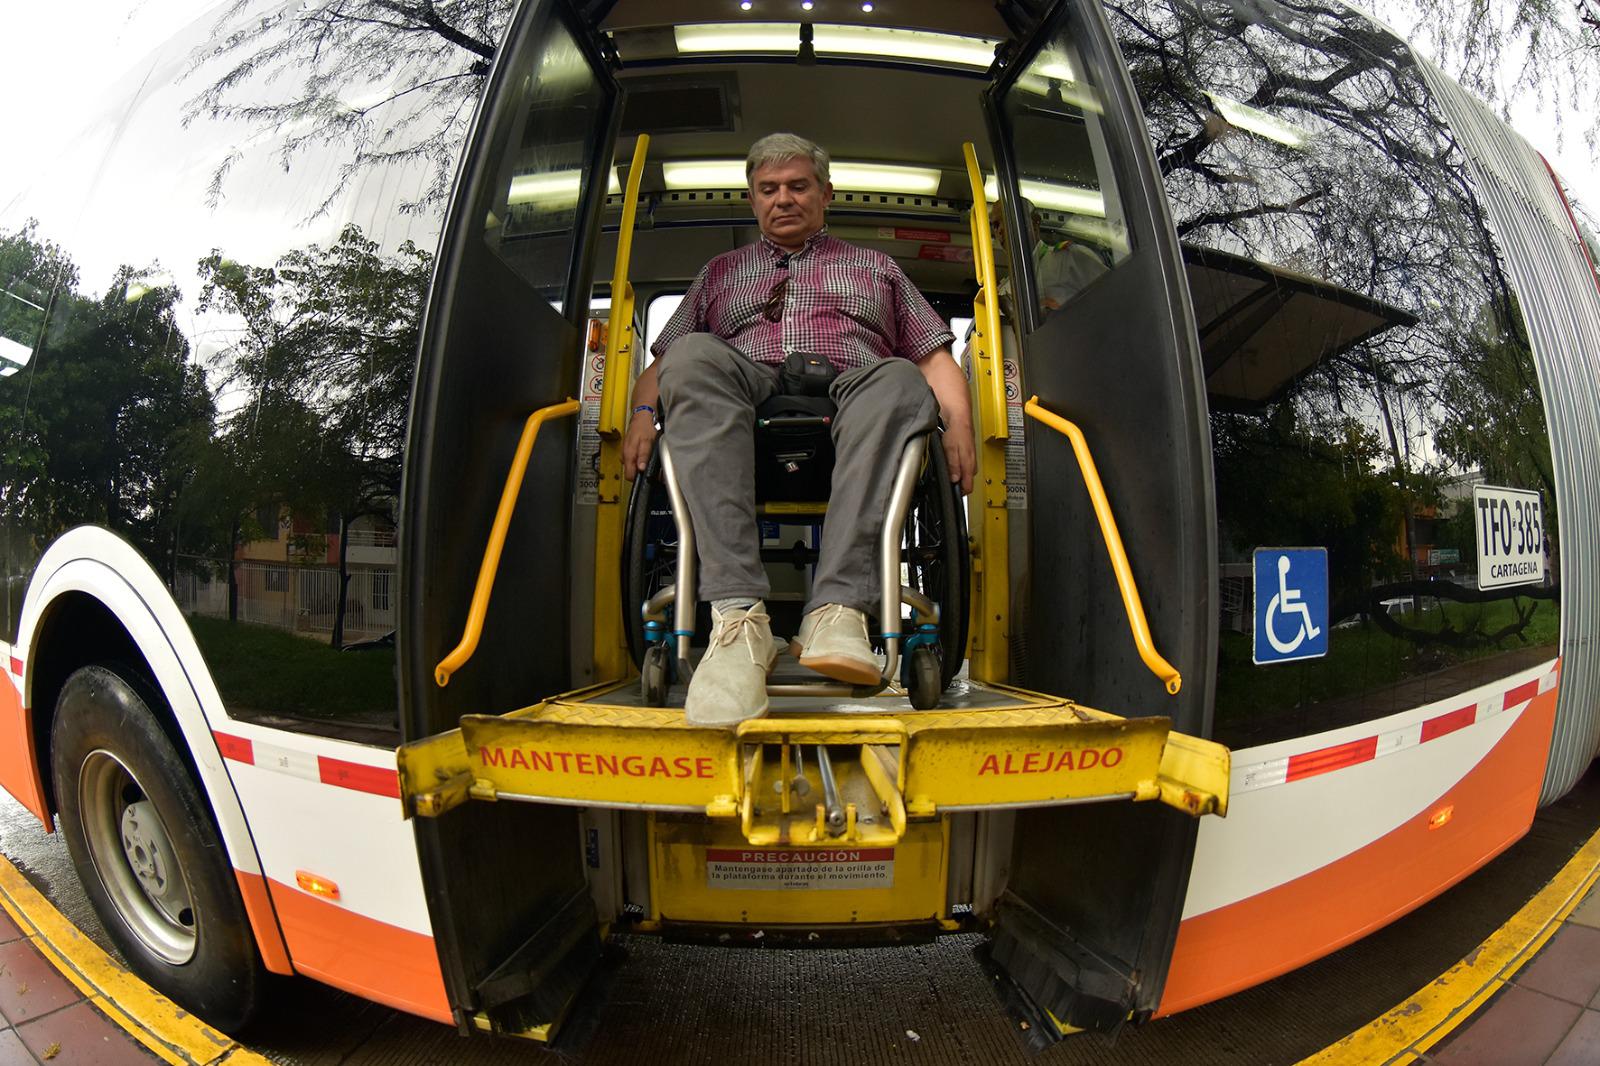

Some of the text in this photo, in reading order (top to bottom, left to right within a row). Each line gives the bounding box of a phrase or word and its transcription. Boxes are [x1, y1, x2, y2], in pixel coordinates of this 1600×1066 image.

[1490, 561, 1538, 578] CARTAGENA
[479, 746, 715, 778] MANTENGASE
[977, 747, 1124, 776] ALEJADO
[742, 850, 860, 862] PRECAUCIÓN
[776, 865, 818, 873] apartado
[821, 865, 833, 873] de
[847, 864, 872, 872] orilla
[723, 872, 775, 880] plataforma
